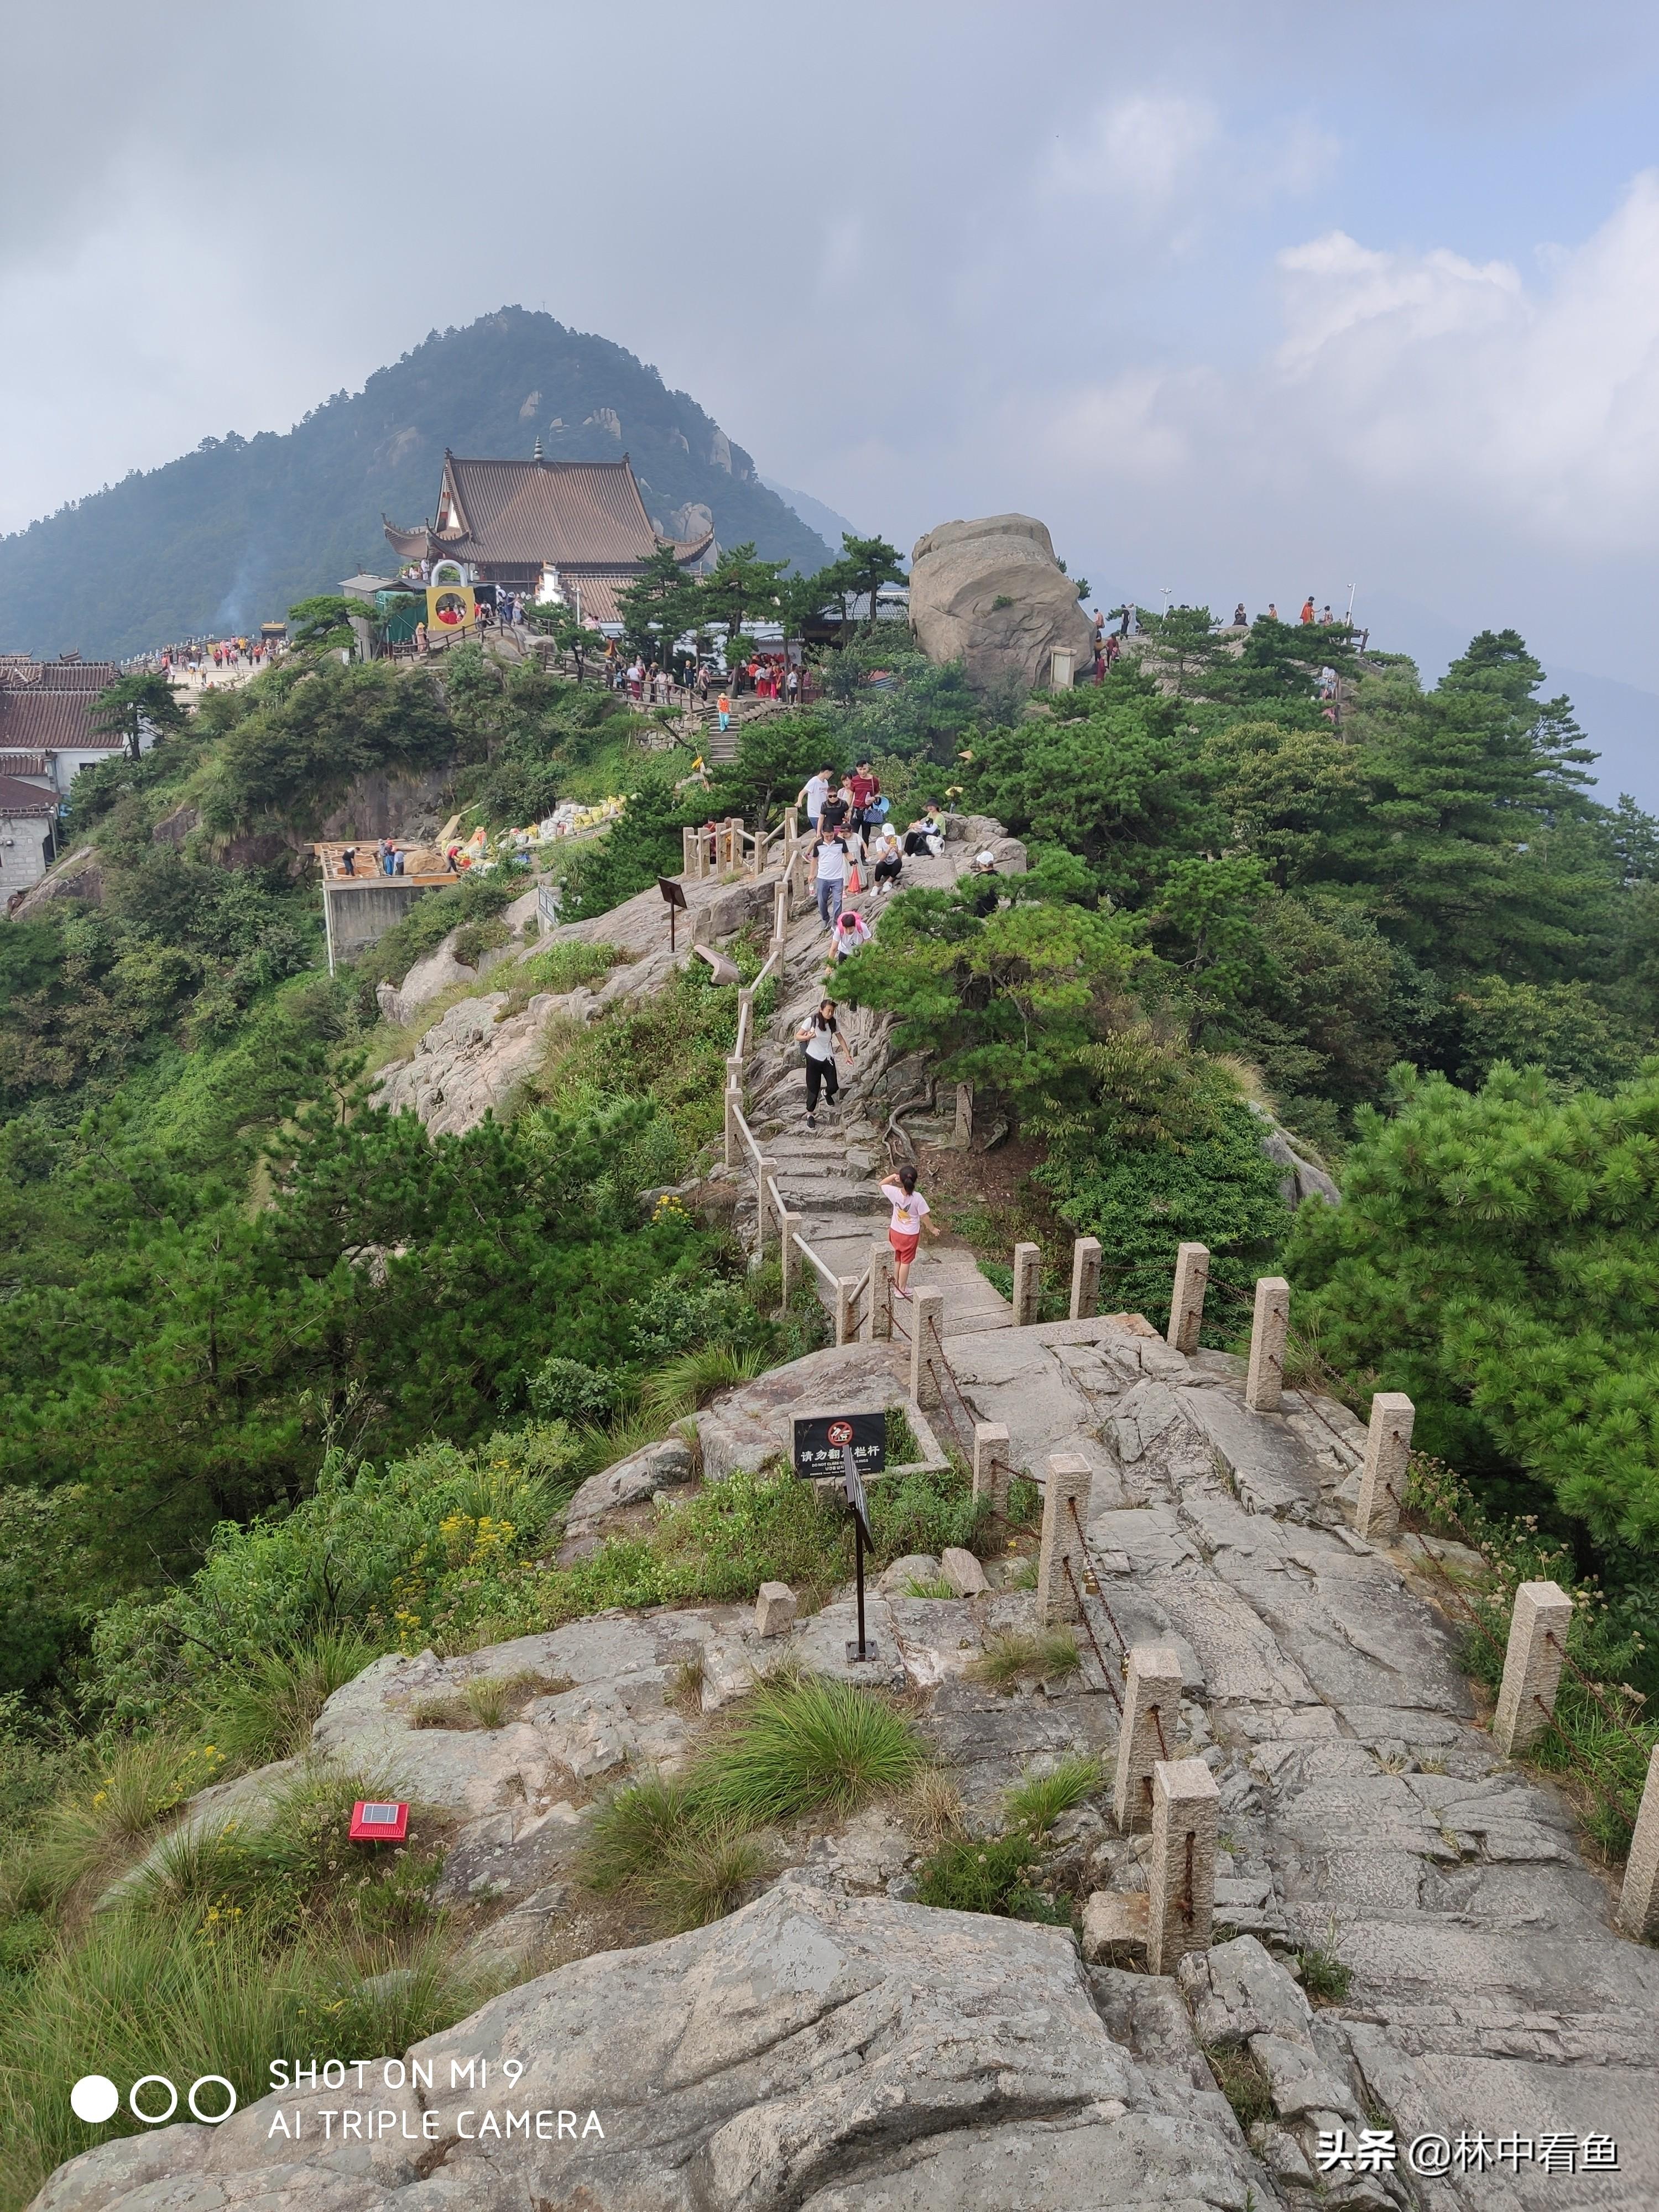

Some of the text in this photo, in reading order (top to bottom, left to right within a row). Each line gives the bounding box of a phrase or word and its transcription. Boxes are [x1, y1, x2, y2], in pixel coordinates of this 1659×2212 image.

[801, 1445, 880, 1462] 请勿翻栏杆
